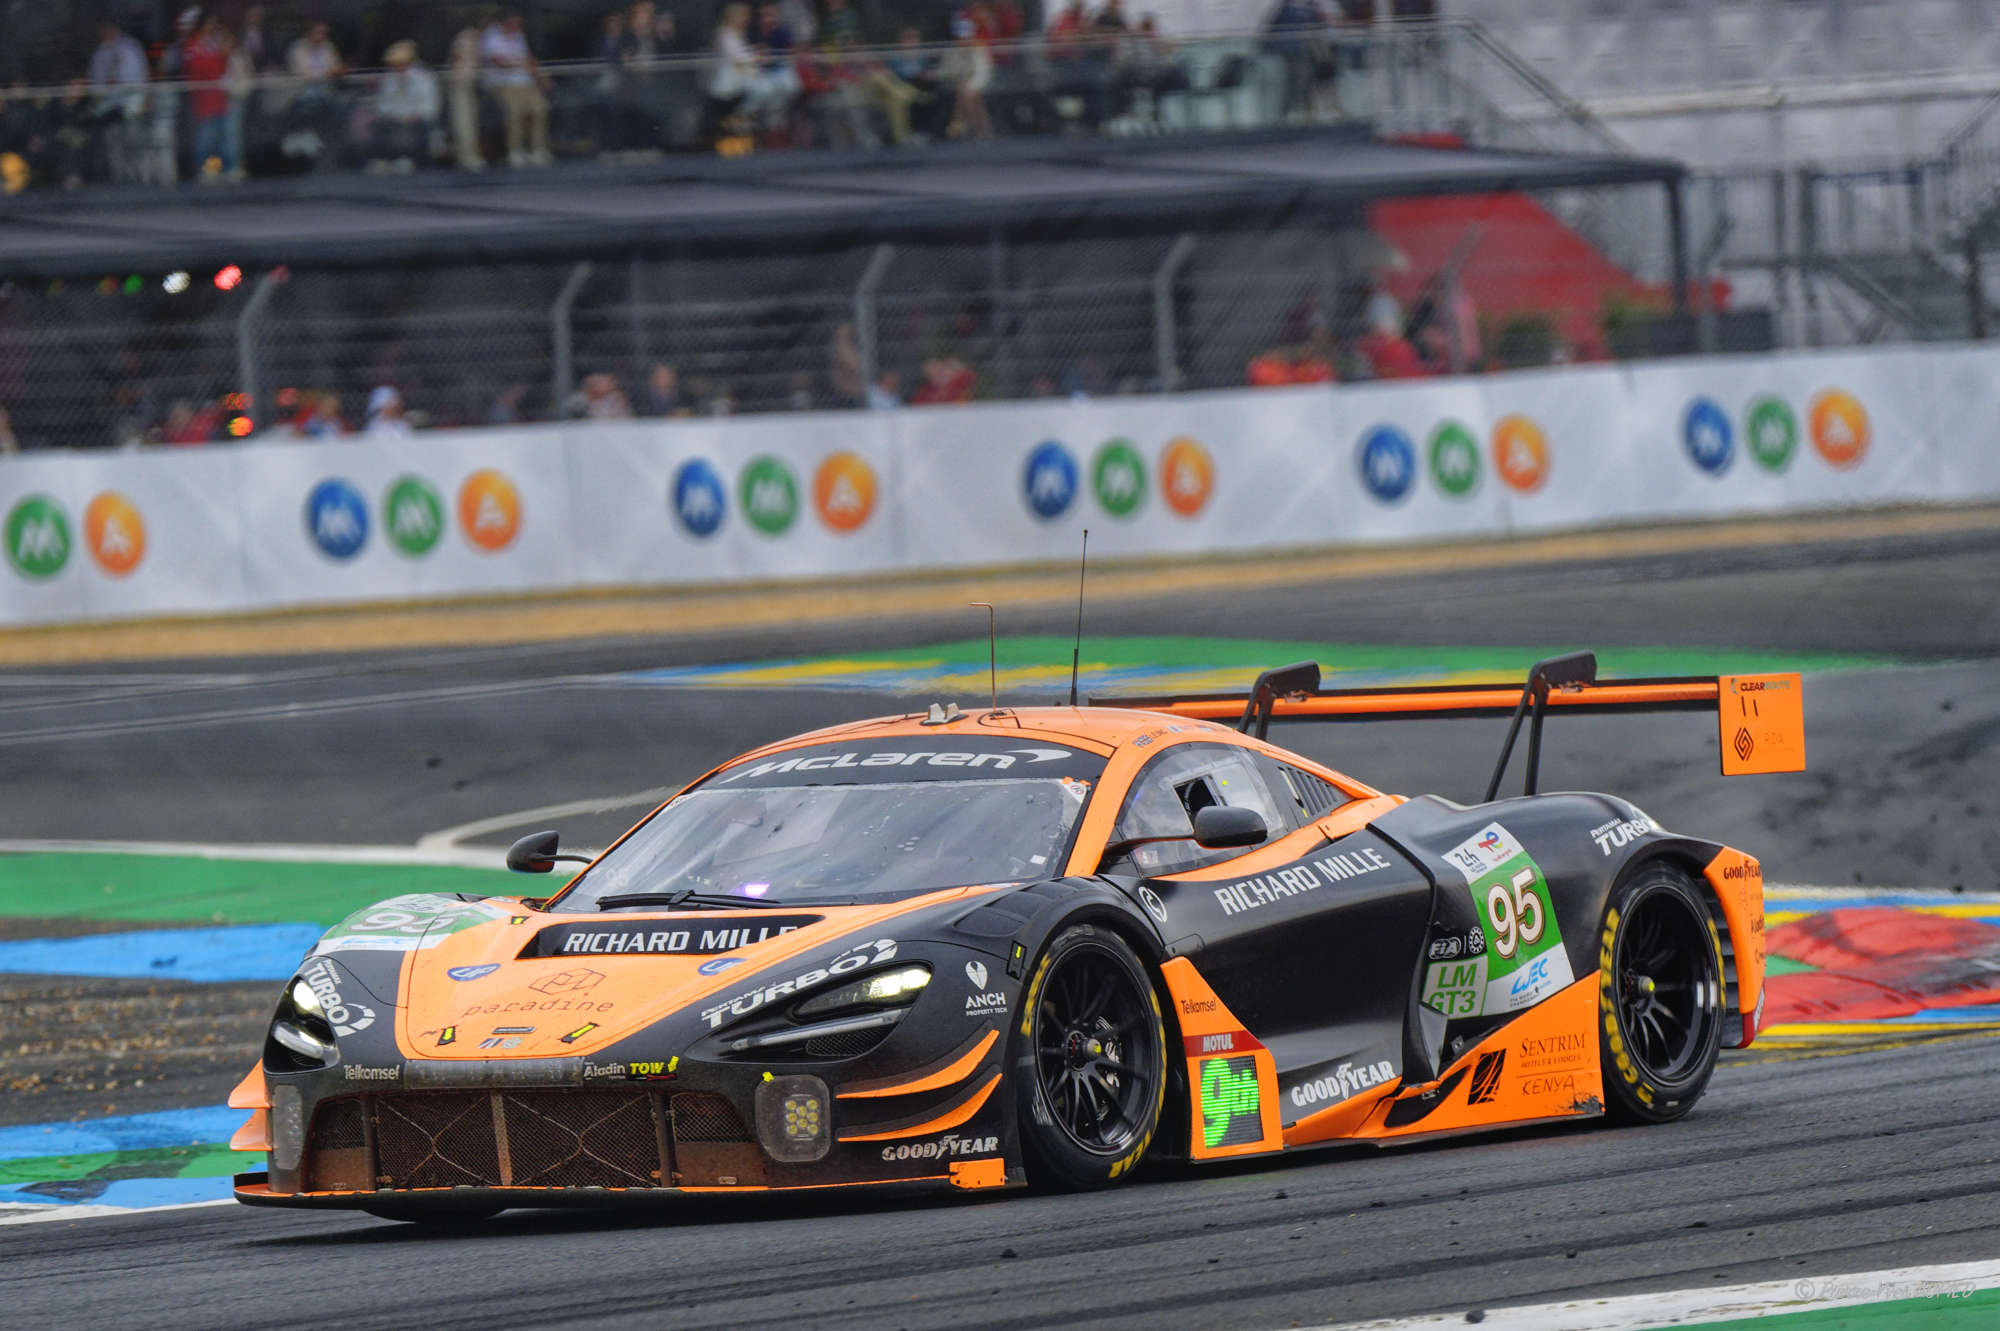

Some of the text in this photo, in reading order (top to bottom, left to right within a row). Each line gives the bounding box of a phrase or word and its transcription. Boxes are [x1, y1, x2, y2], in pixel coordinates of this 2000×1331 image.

[317, 501, 361, 540] M
[474, 492, 509, 530] A
[18, 516, 131, 561] M A
[719, 751, 1020, 785] McLaren
[1213, 847, 1392, 916] RICHARD MILLE
[1487, 865, 1545, 960] 95
[563, 931, 692, 953] RICHARD
[1437, 963, 1478, 989] LM
[1511, 956, 1549, 995] WEC
[304, 962, 350, 1024] TURBO
[702, 955, 869, 1029] TURBO
[965, 991, 1007, 1009] ANCH
[1428, 989, 1477, 1015] GT3
[459, 996, 615, 1019] paradine
[1181, 998, 1217, 1015] Telkomsel
[1202, 1032, 1235, 1053] MOTUL
[1519, 1033, 1586, 1059] SENTRIM
[343, 1063, 401, 1081] Telkomsel
[584, 1063, 626, 1077] Aladin
[630, 1061, 665, 1075] TOW
[1290, 1061, 1397, 1107] GOODYEAR
[1522, 1074, 1576, 1096] KENYA
[881, 1134, 999, 1161] GOODYEAR
